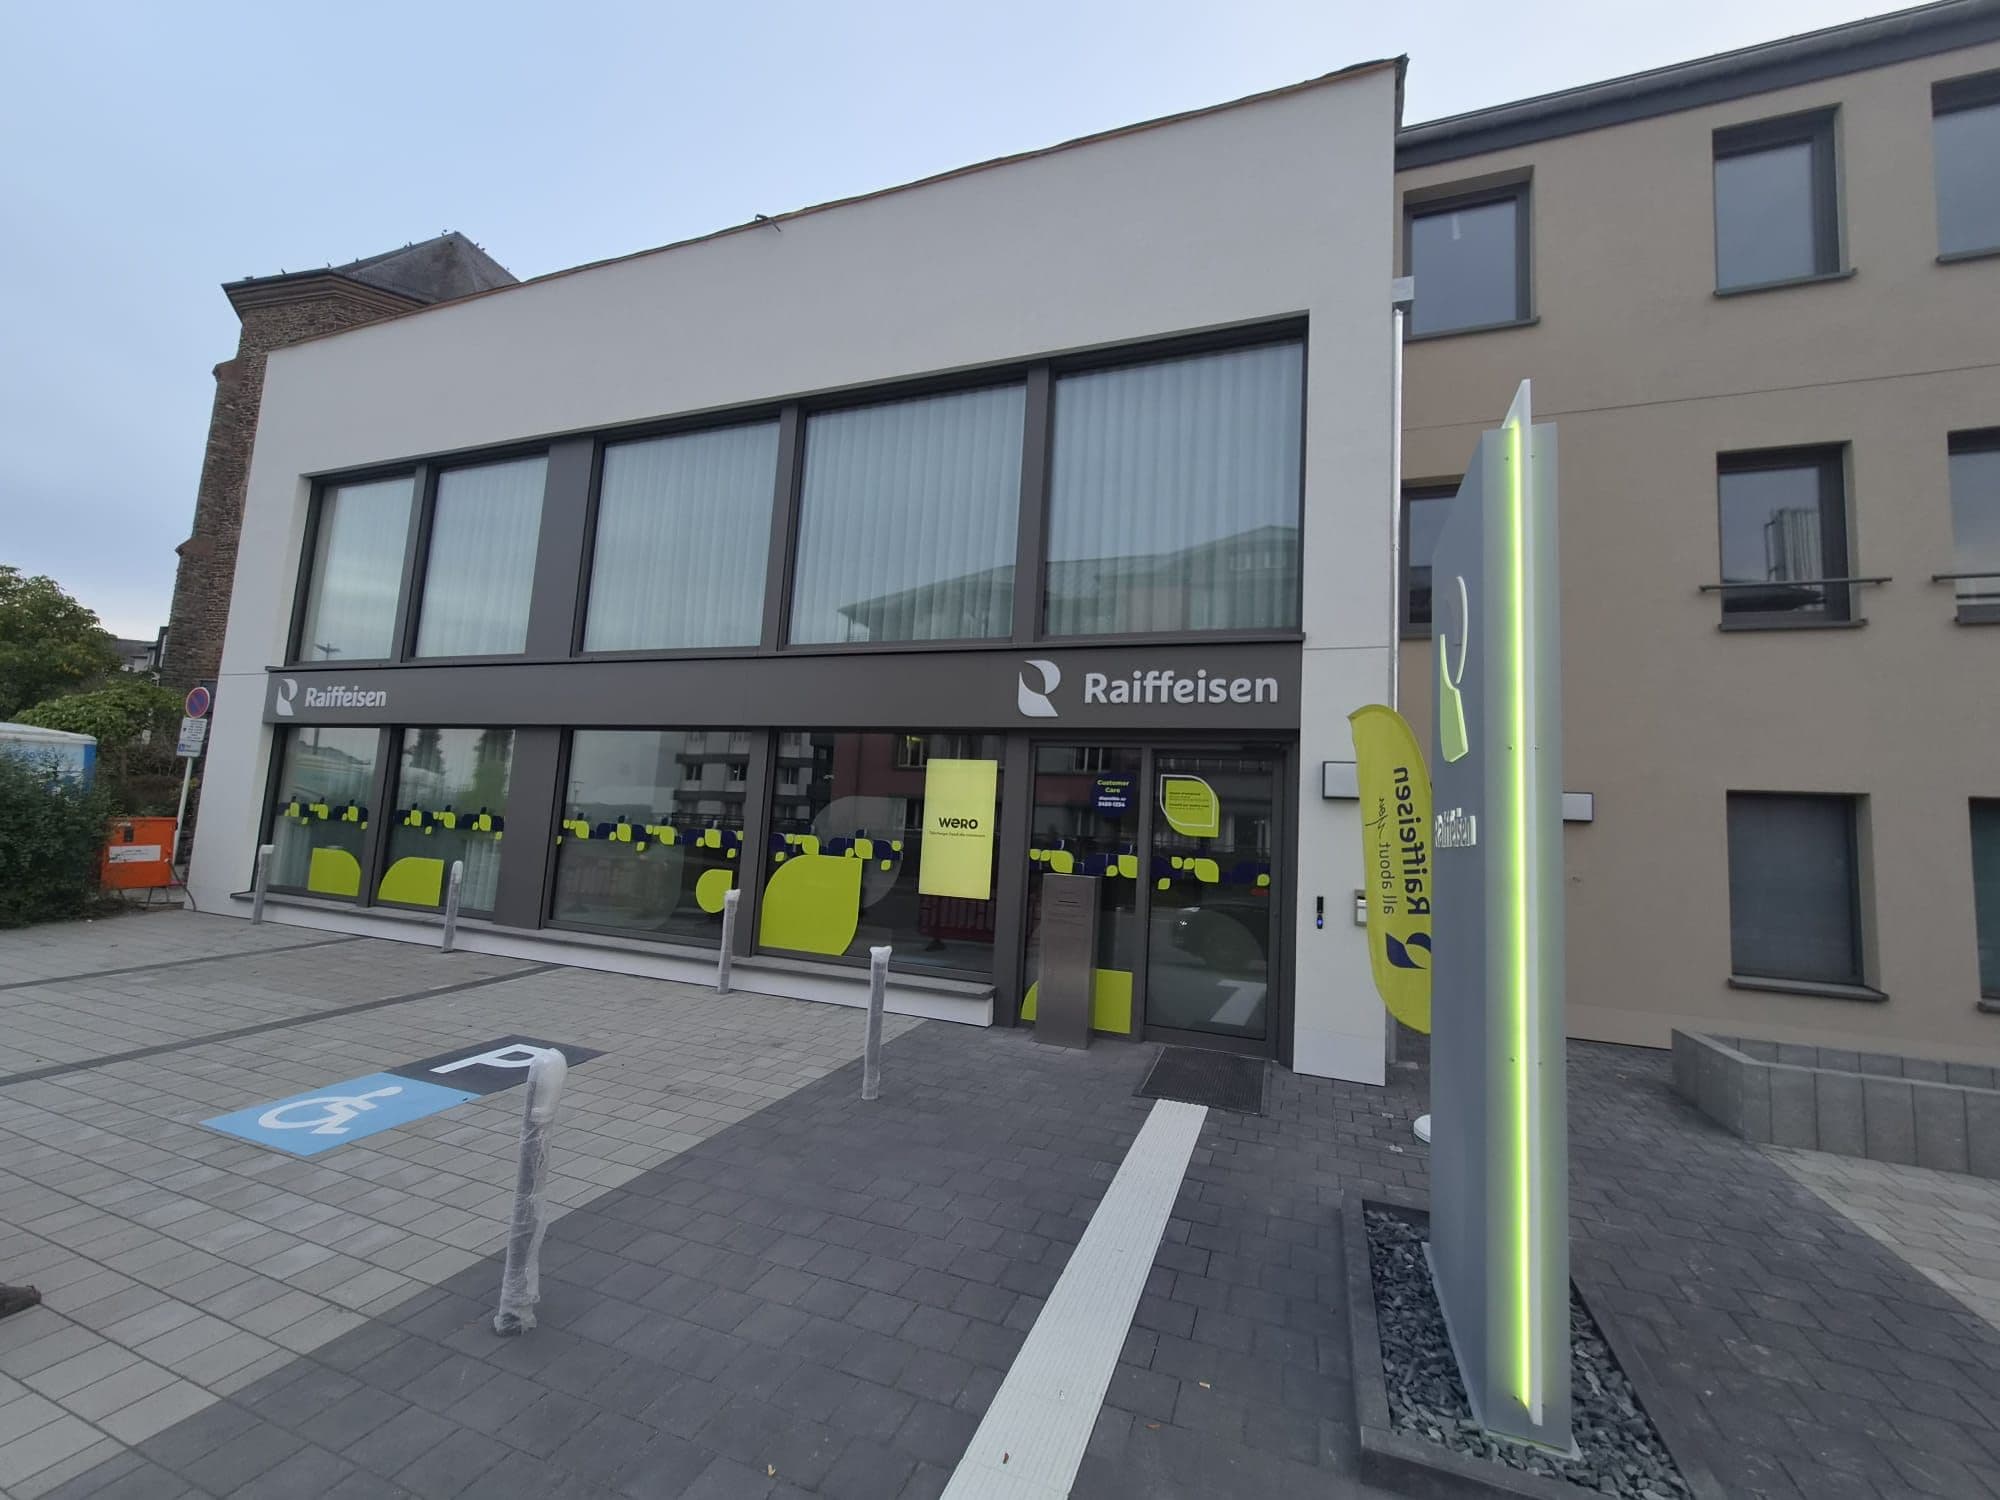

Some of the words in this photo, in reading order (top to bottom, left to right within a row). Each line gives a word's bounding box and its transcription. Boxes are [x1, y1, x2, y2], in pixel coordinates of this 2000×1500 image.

[304, 686, 387, 708] Raiffeisen
[1083, 669, 1279, 704] Raiffeisen
[428, 1043, 547, 1074] P
